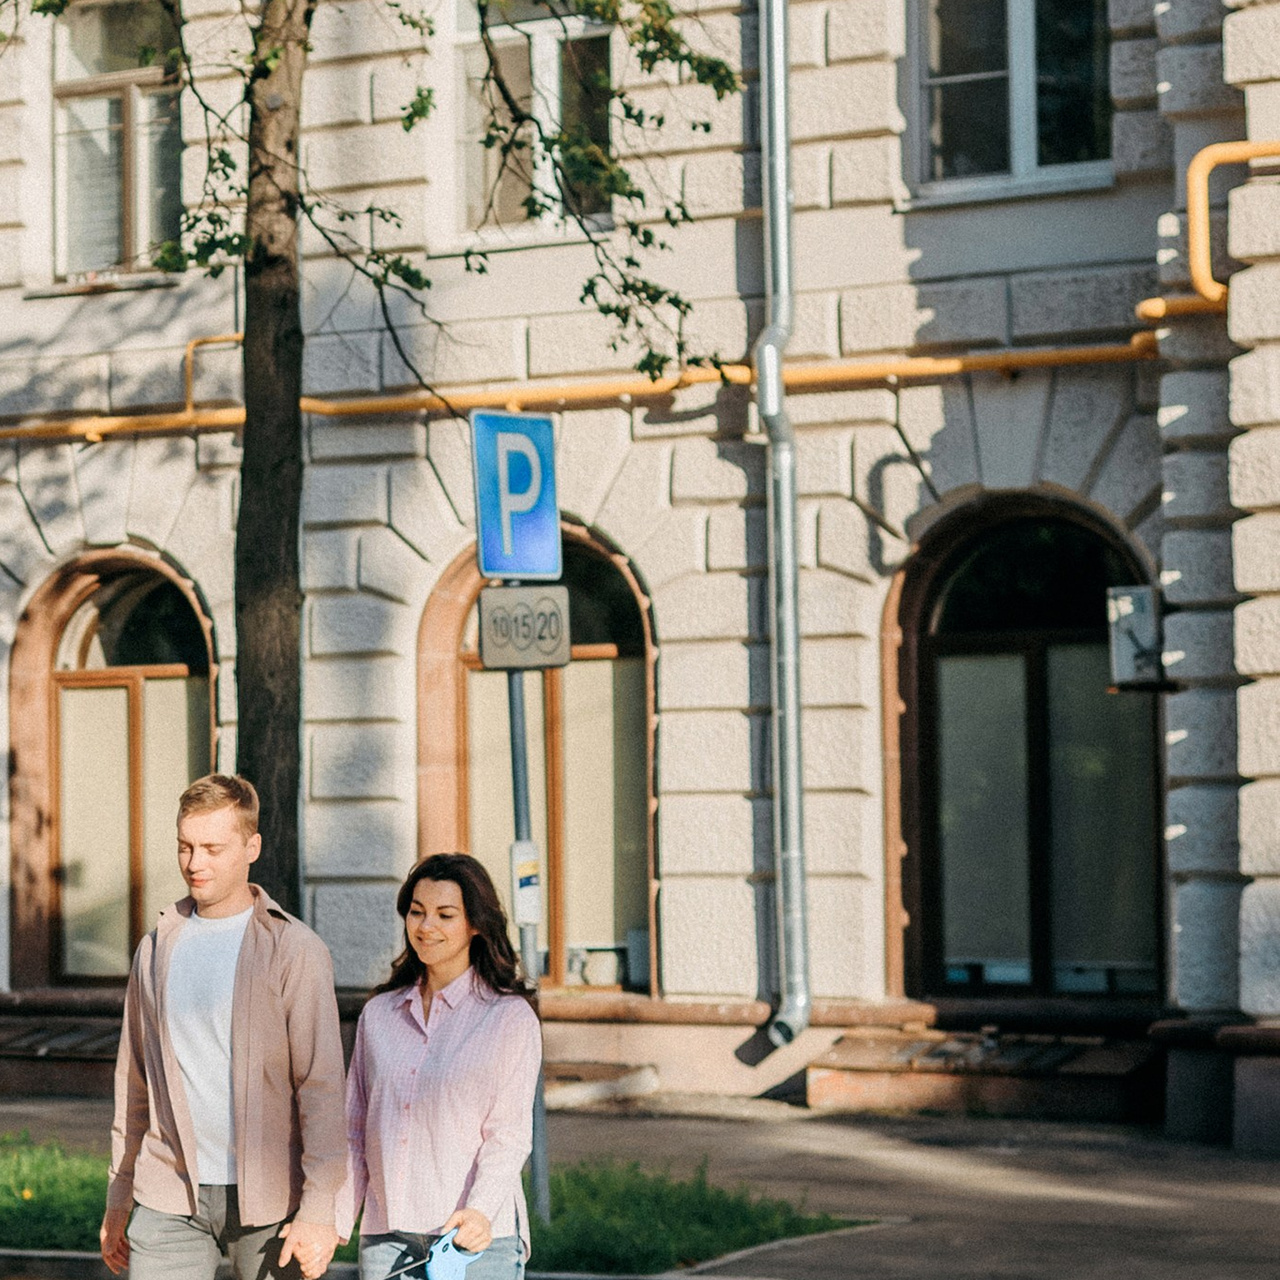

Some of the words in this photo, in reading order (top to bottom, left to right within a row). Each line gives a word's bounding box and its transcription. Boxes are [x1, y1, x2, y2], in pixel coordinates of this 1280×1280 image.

[495, 432, 542, 556] P
[492, 615, 510, 638] 10
[513, 612, 532, 639] 15
[537, 611, 561, 640] 20
